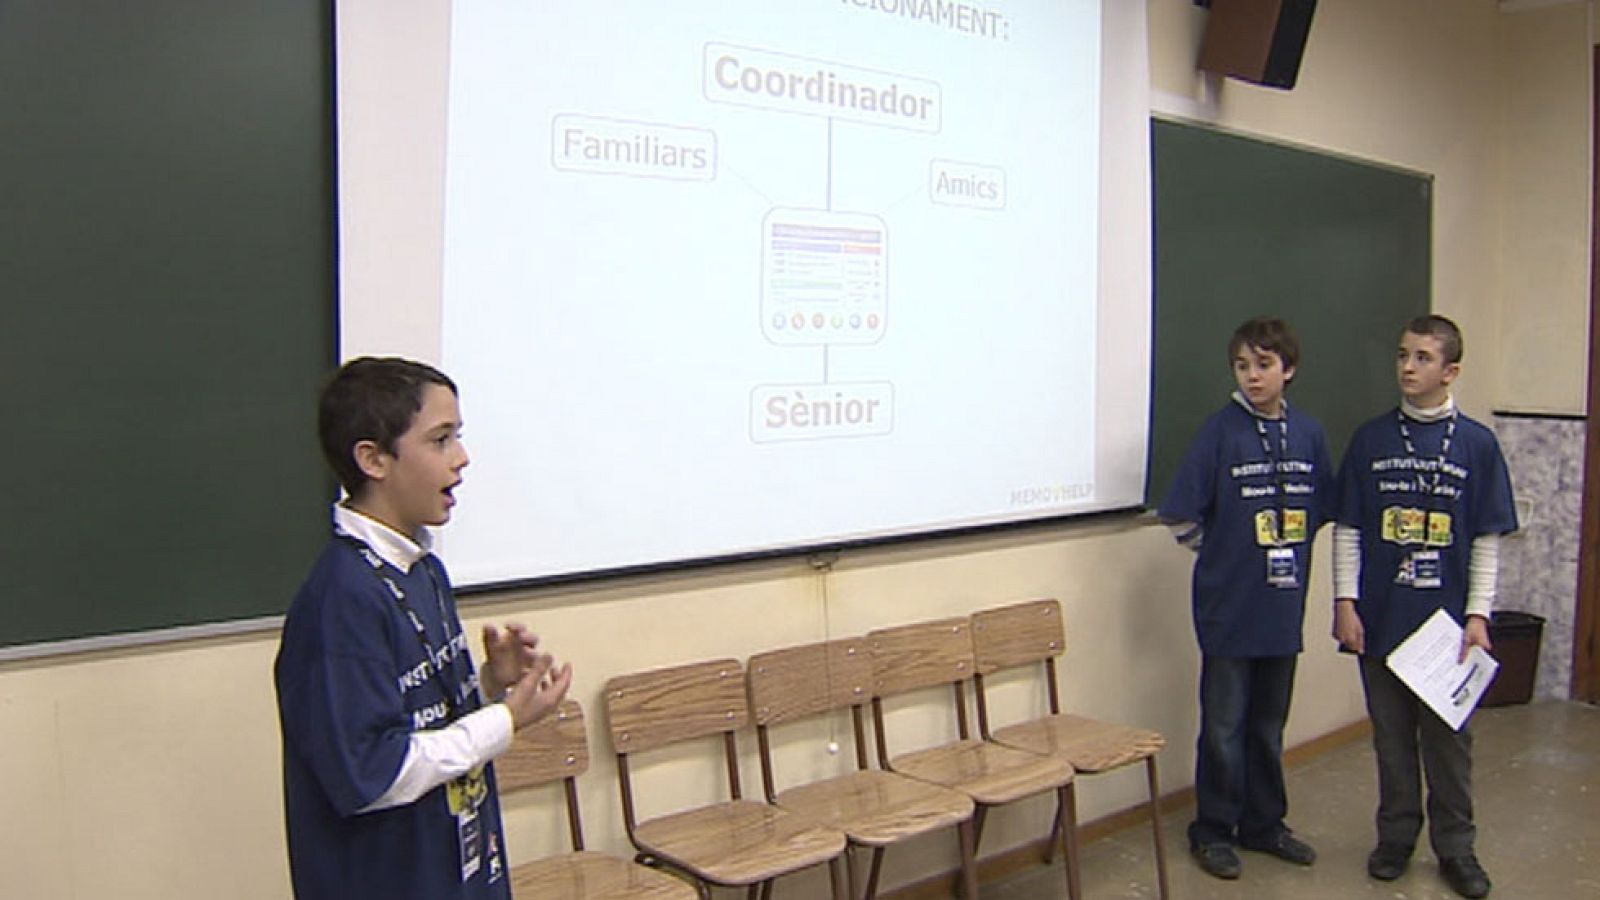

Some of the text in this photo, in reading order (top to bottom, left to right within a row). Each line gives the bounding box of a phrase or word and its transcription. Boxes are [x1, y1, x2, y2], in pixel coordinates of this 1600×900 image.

[714, 55, 934, 120] Coordinador
[564, 128, 708, 169] Familiars
[936, 171, 999, 200] Amics
[765, 391, 880, 428] Sènior
